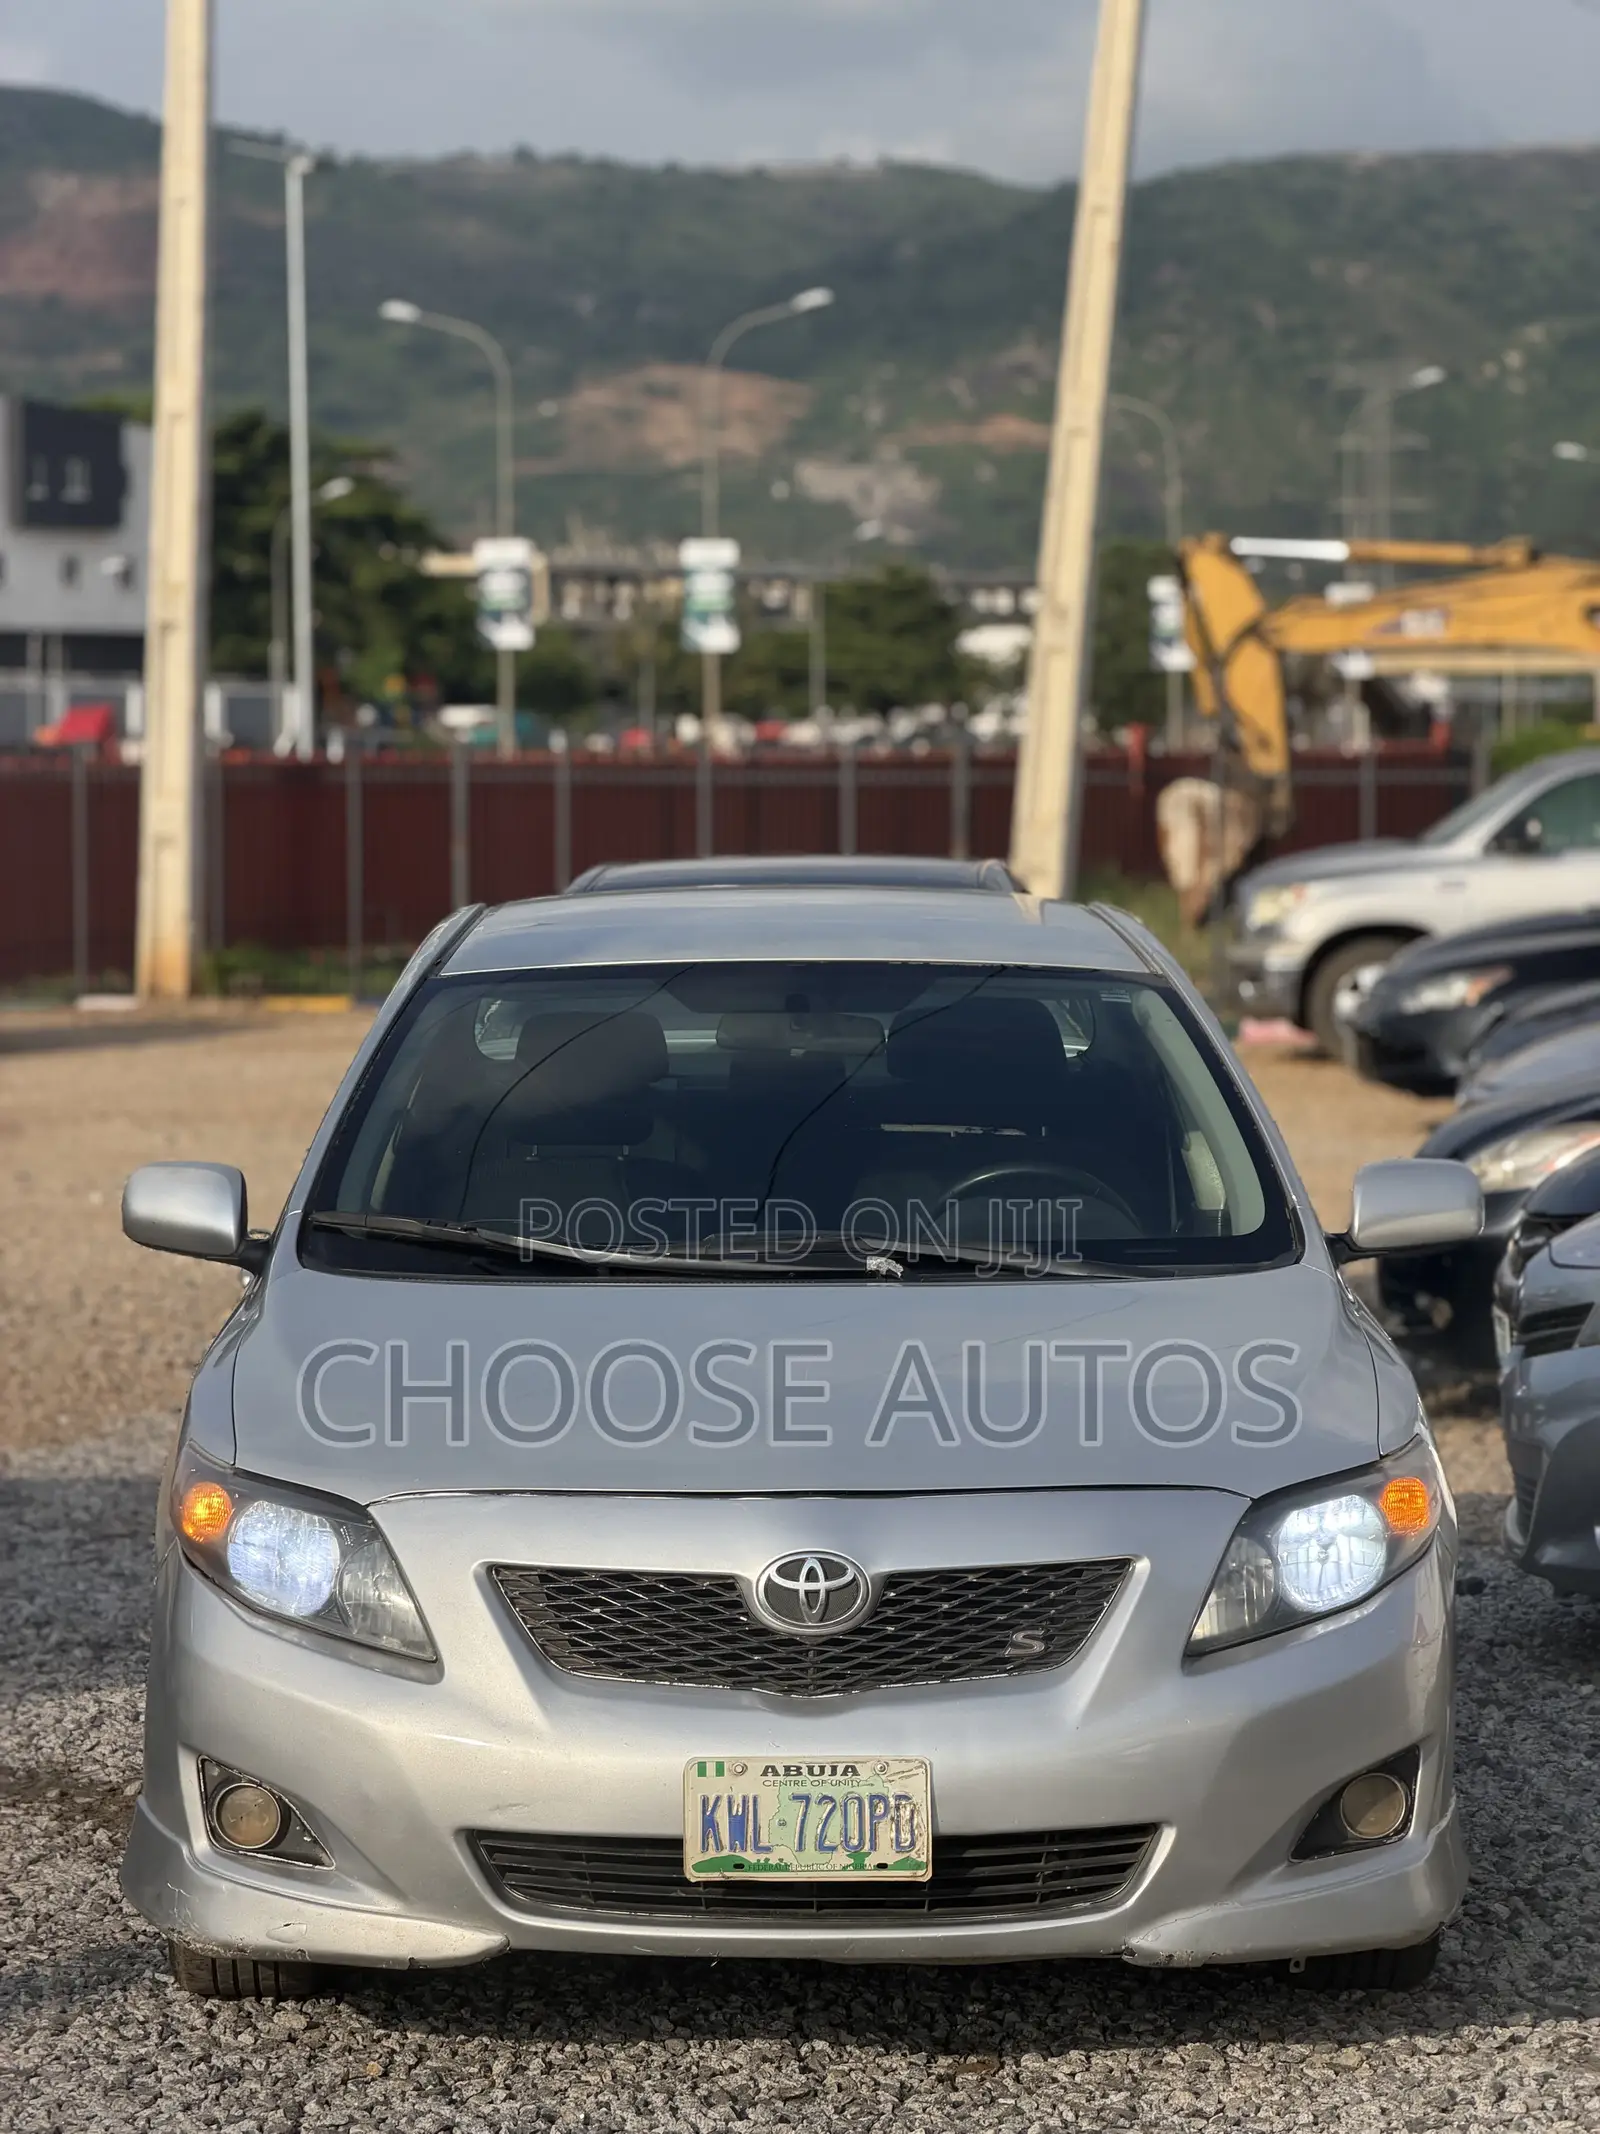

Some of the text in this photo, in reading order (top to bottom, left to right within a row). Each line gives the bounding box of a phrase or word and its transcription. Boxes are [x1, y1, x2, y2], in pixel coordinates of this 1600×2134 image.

[760, 1765, 860, 1777] ABUJA
[831, 1780, 861, 1788] UNITY
[700, 1793, 917, 1853] KWL 720PD
[748, 1863, 785, 1871] FEDERAL
[786, 1863, 824, 1871] REPUBLIC
[825, 1863, 837, 1871] OF
